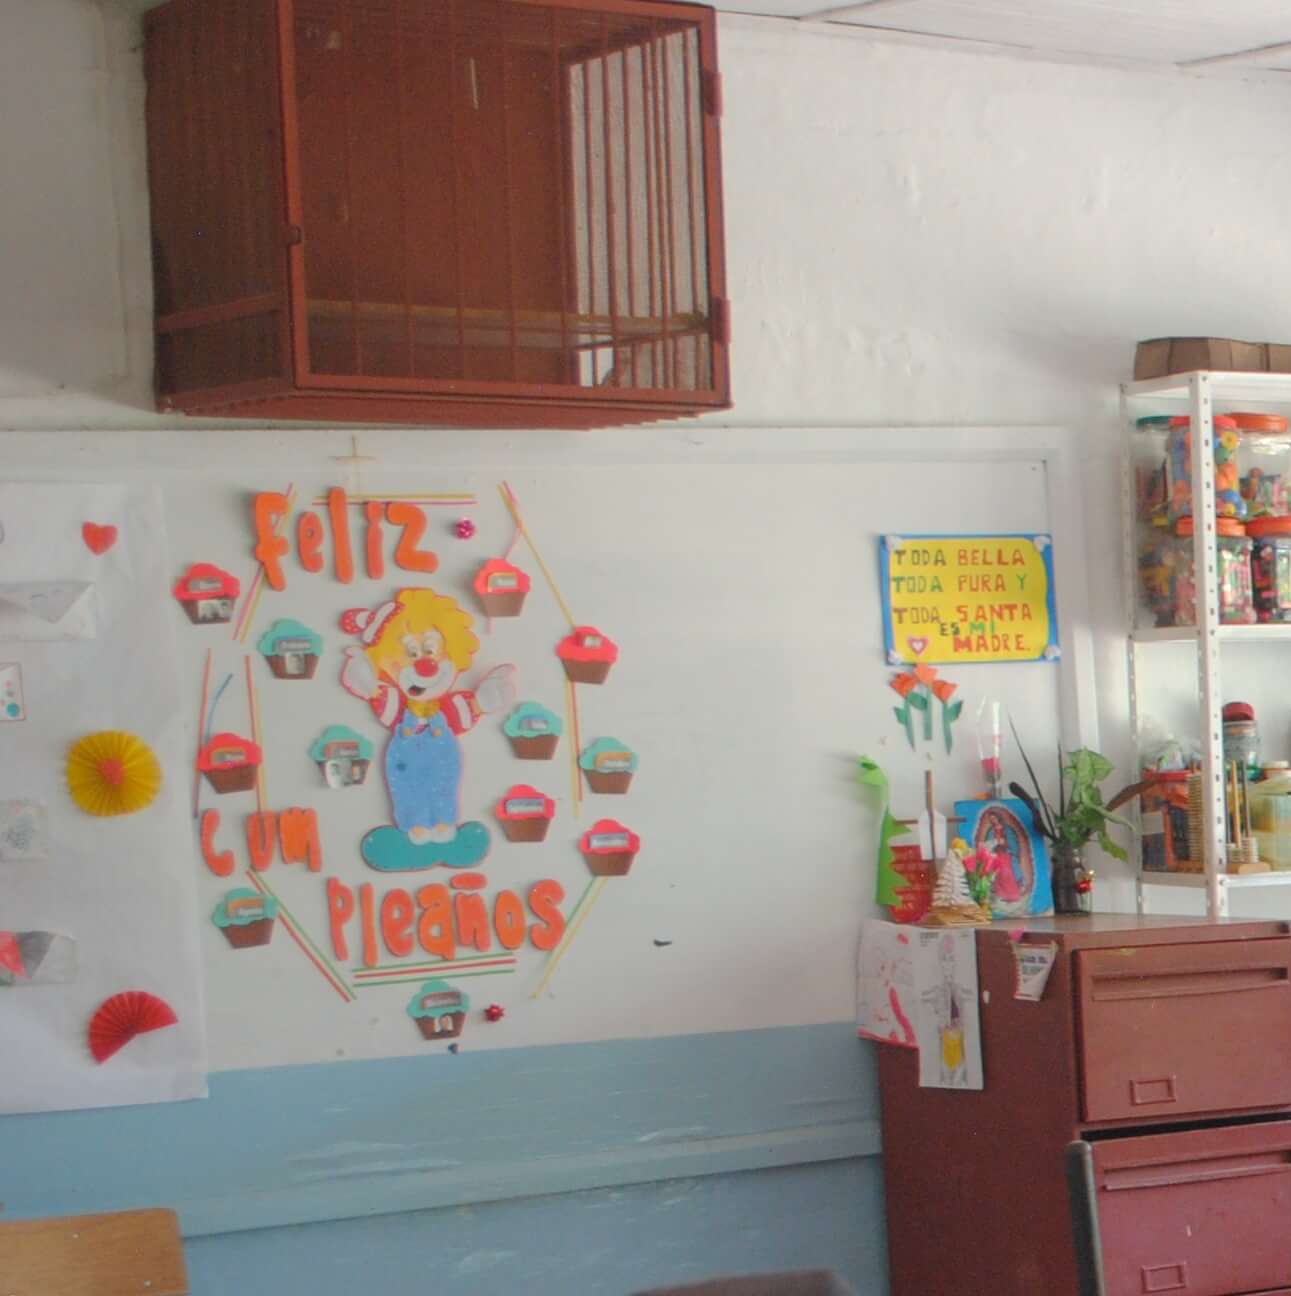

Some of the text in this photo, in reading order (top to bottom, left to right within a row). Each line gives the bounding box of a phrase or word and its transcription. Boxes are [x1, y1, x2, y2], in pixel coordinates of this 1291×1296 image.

[894, 548, 1025, 566] TODA BELLA
[892, 575, 944, 593] TODA
[1016, 573, 1027, 592] Y
[955, 603, 1032, 623] SANTA
[939, 620, 997, 637] ES MI
